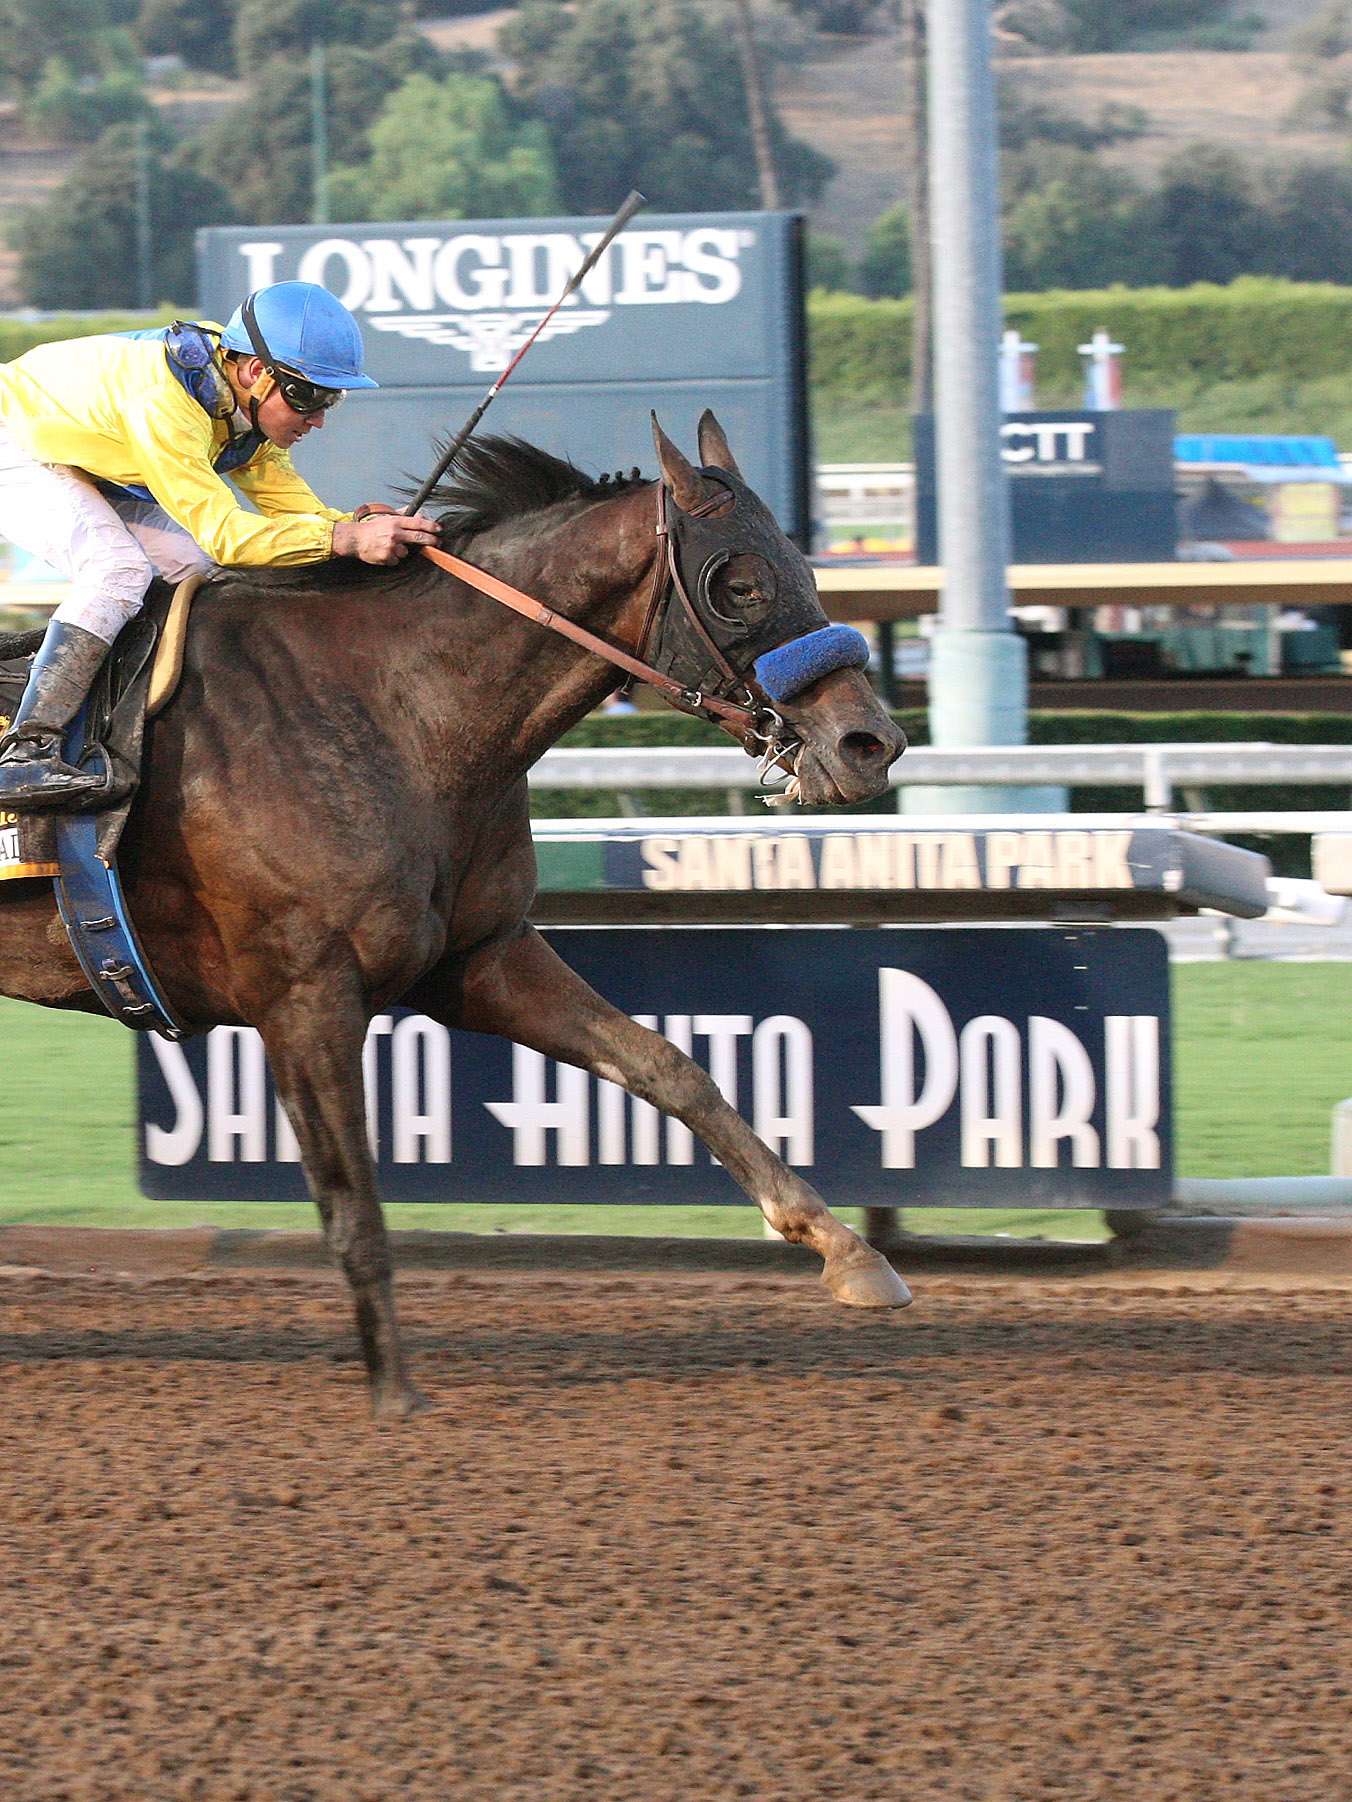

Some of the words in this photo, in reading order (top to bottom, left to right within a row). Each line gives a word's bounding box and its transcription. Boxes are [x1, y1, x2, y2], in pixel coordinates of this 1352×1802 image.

[239, 227, 742, 311] LONGINES
[641, 832, 818, 891] SANTA
[819, 831, 983, 890] ANITA
[984, 830, 1136, 889] PARK
[849, 967, 1160, 1169] PARK
